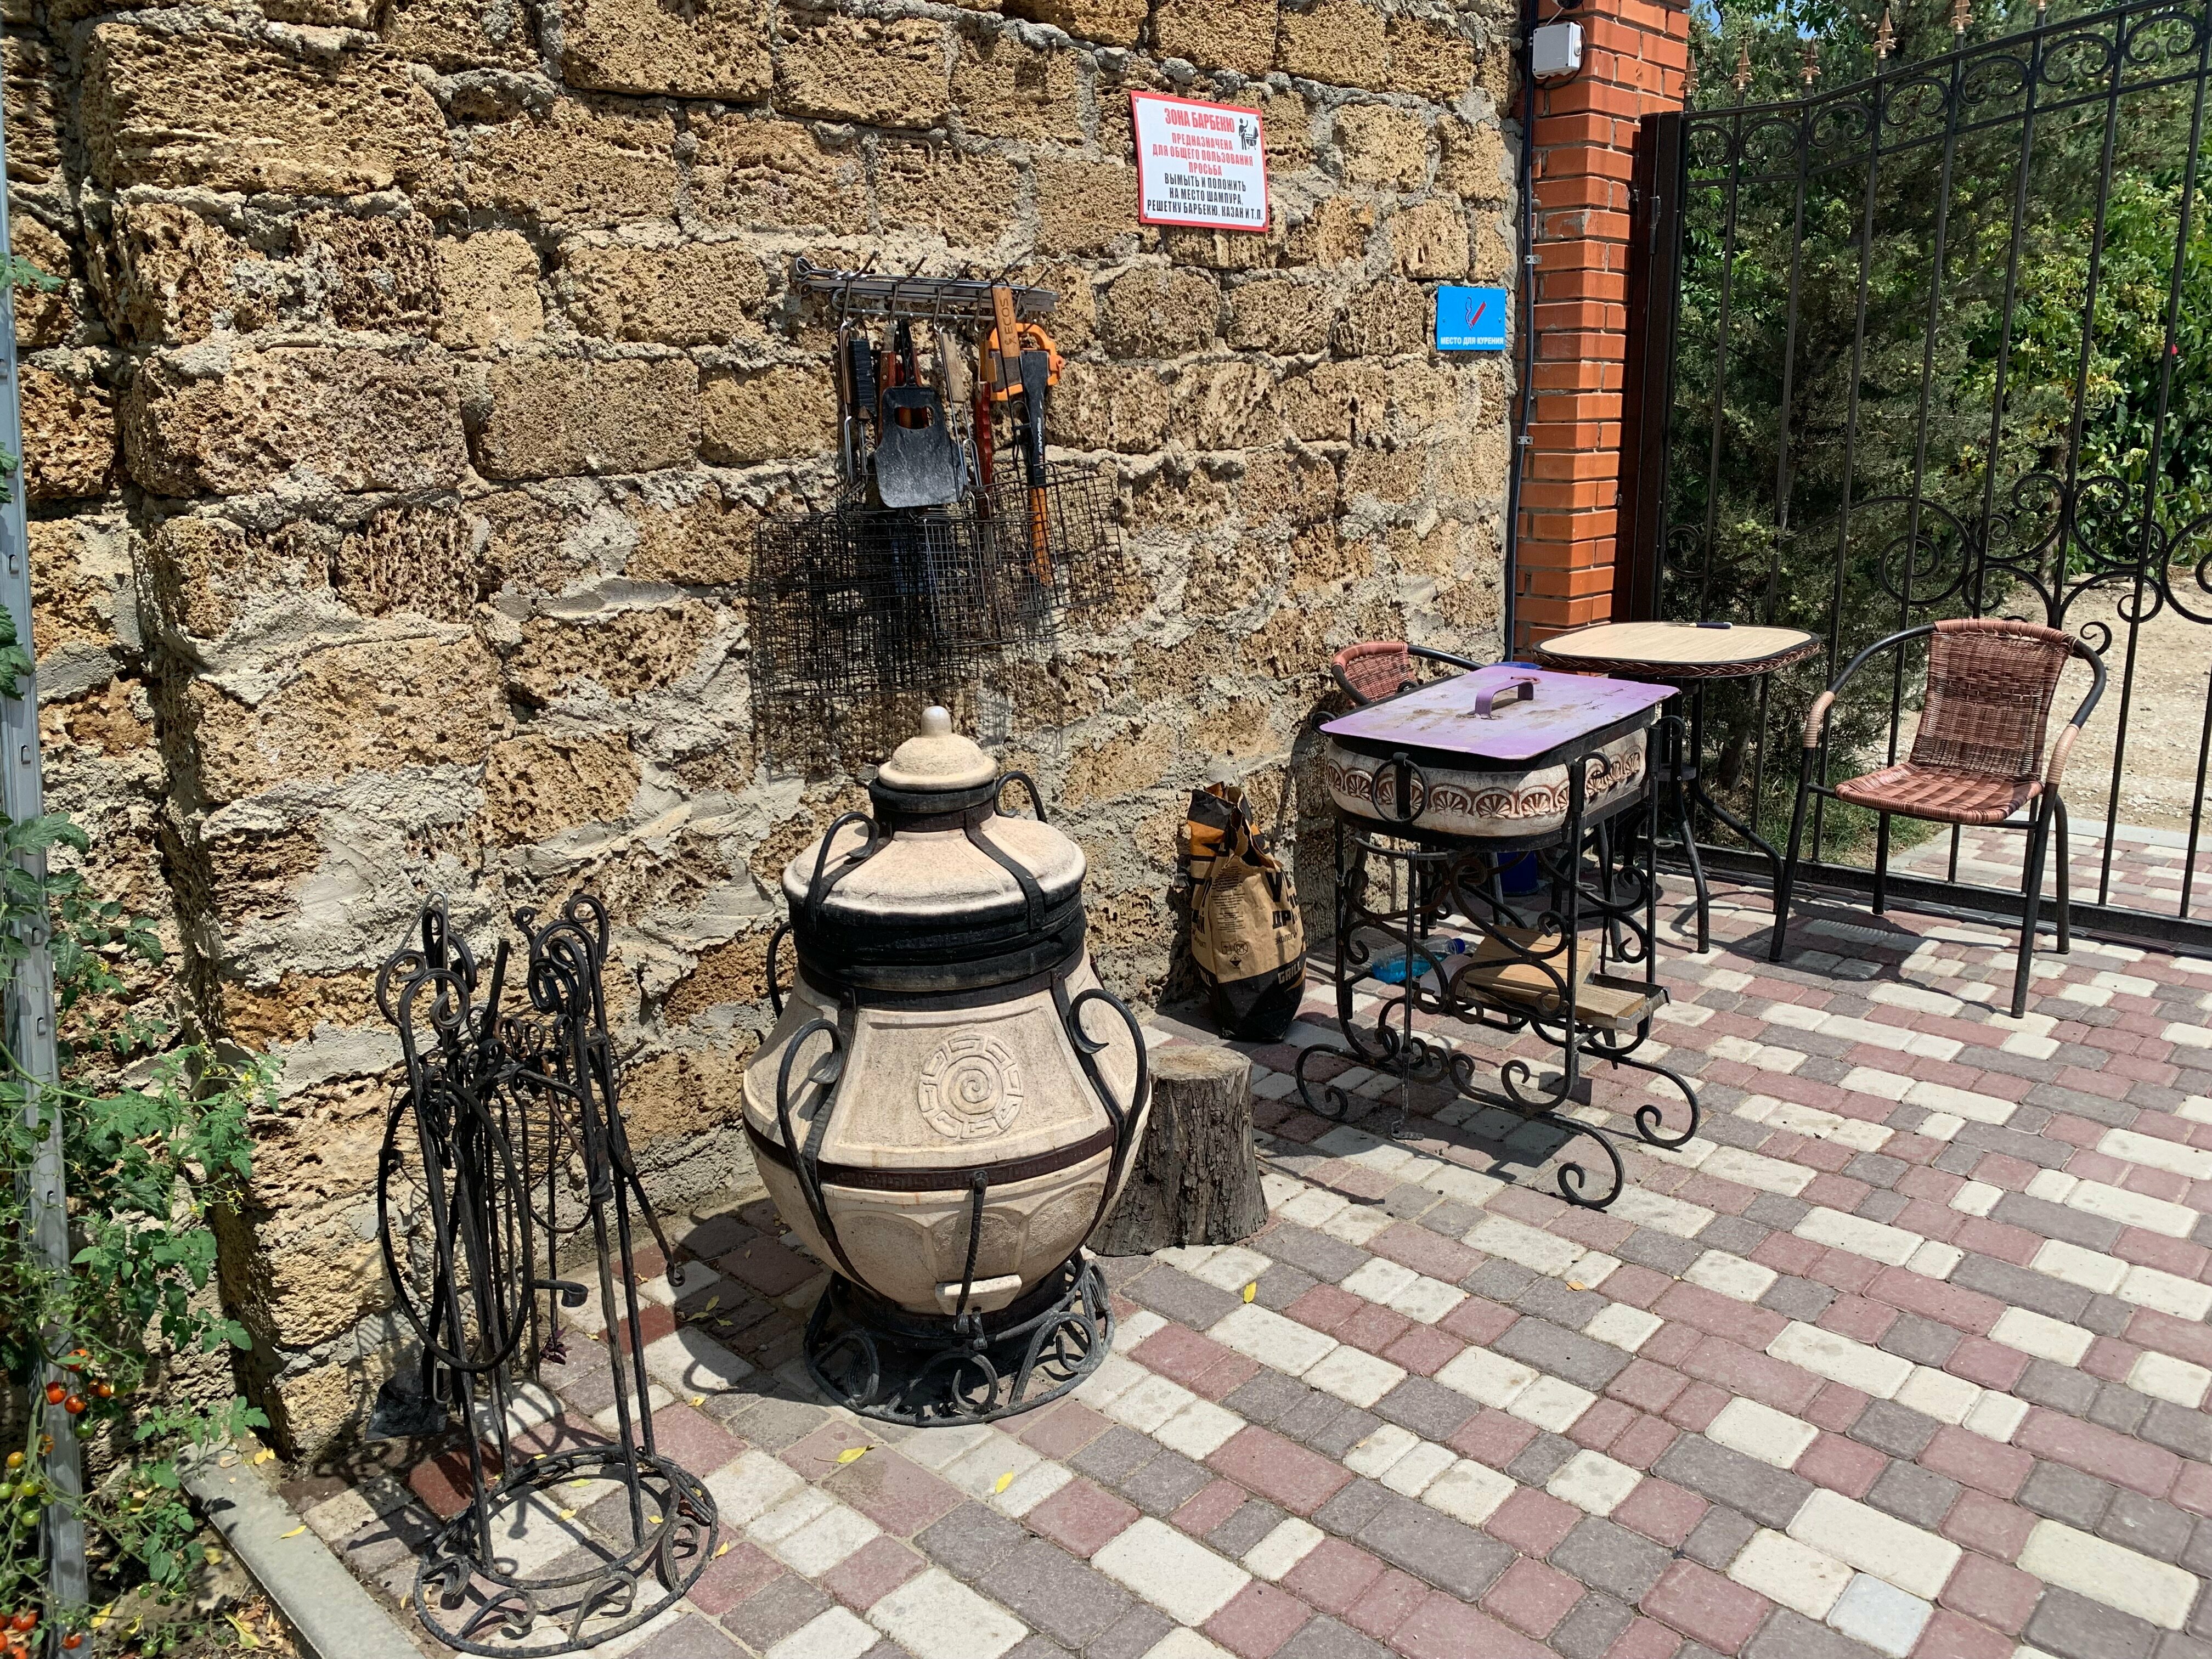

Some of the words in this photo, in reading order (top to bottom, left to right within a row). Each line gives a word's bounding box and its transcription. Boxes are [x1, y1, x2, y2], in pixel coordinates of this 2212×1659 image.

[1164, 108, 1190, 127] ЗОНА
[1192, 111, 1235, 133] БАРБЕКЮ
[1171, 132, 1233, 151] ПРЕДНАЗНАЧЕНА
[1153, 144, 1168, 157] ДЛЯ
[1170, 146, 1200, 160] ОБЩЕГО
[1201, 150, 1254, 166] ПОЛЬЗОВАНИЯ
[1188, 162, 1222, 176] ПРОСЬБА
[1165, 173, 1200, 187] ВЫМЫТЬ
[1201, 176, 1206, 188] И
[1207, 177, 1246, 191] ПОЛОЖИТЬ
[1169, 187, 1180, 199] НА
[1181, 188, 1205, 201] МЕСТО
[1207, 191, 1243, 205] ШАМПУРА,
[1147, 199, 1181, 213] РЕШЕТКУ
[1183, 202, 1220, 217] БАРБЕКЮ,
[1222, 206, 1244, 218] КАЗАН
[1245, 208, 1249, 218] И
[1251, 208, 1263, 219] Т.П.
[1000, 298, 1013, 334] ECOS
[1440, 336, 1462, 345] МЕСТО
[1463, 336, 1476, 346] ДЛЯ
[1278, 961, 1301, 984] GRILL
